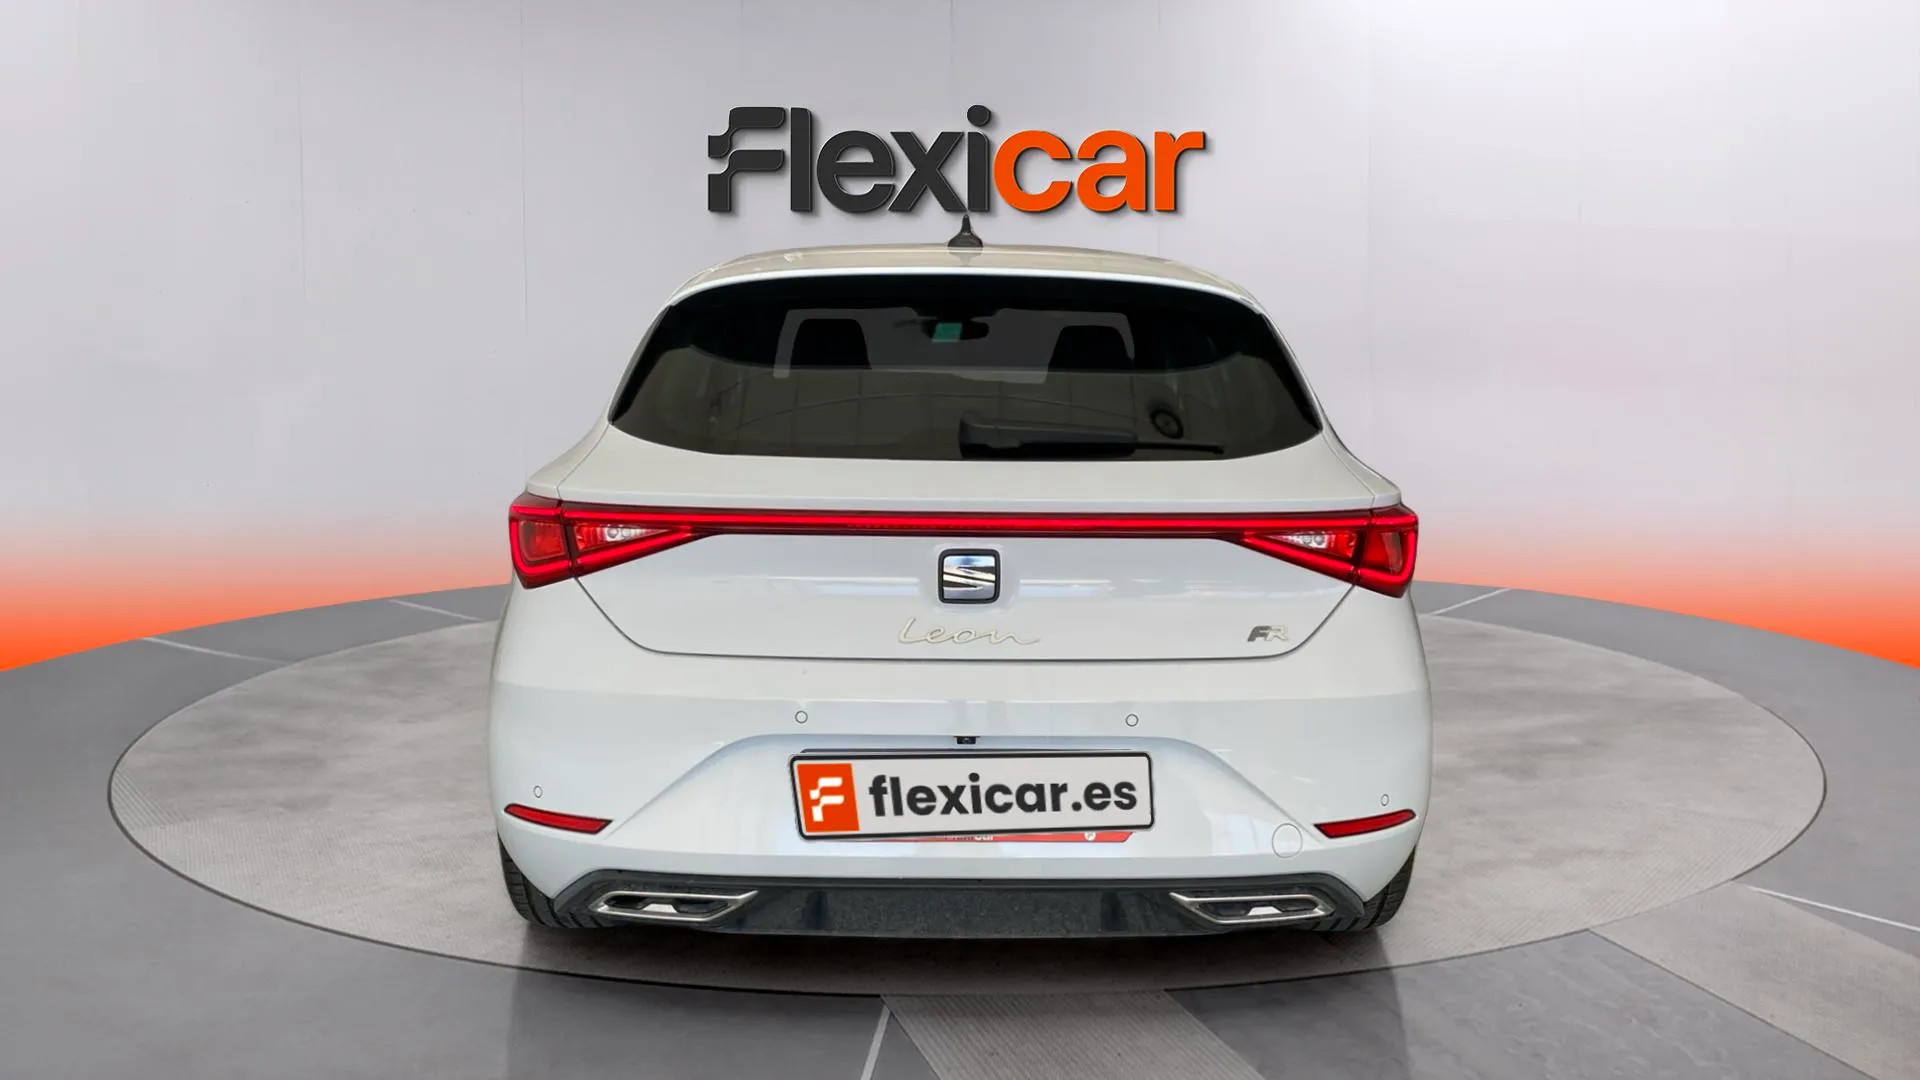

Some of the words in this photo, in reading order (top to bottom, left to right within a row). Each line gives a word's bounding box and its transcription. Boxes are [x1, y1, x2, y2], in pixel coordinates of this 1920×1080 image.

[708, 105, 1205, 212] Flexicar
[898, 616, 1041, 645] Leon
[1247, 625, 1289, 642] FR
[868, 772, 1138, 817] flexicar.es
